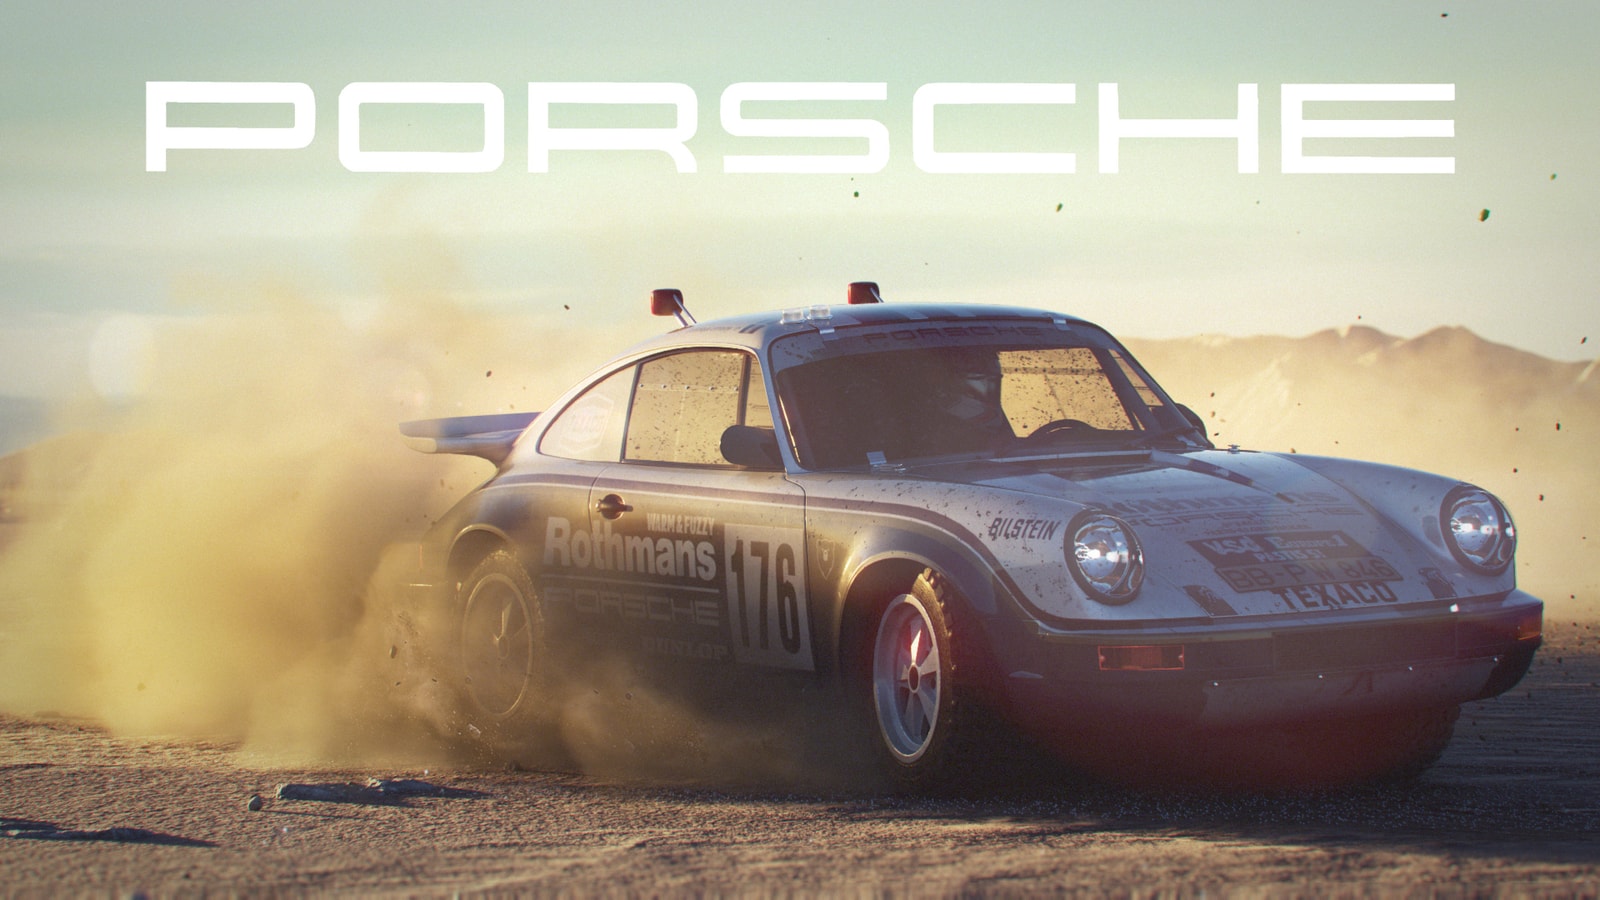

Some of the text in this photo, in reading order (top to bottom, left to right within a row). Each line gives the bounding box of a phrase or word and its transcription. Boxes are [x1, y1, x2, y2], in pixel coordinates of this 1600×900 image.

[862, 325, 1041, 345] PORSCHE
[646, 512, 716, 536] WARM & FUZZY
[988, 517, 1062, 540] BILSTEIN
[542, 516, 717, 581] Rothmans
[1340, 559, 1396, 578] 846
[731, 534, 800, 653] 176
[1268, 581, 1398, 609] TEXACO
[543, 587, 719, 627] PORSCHE
